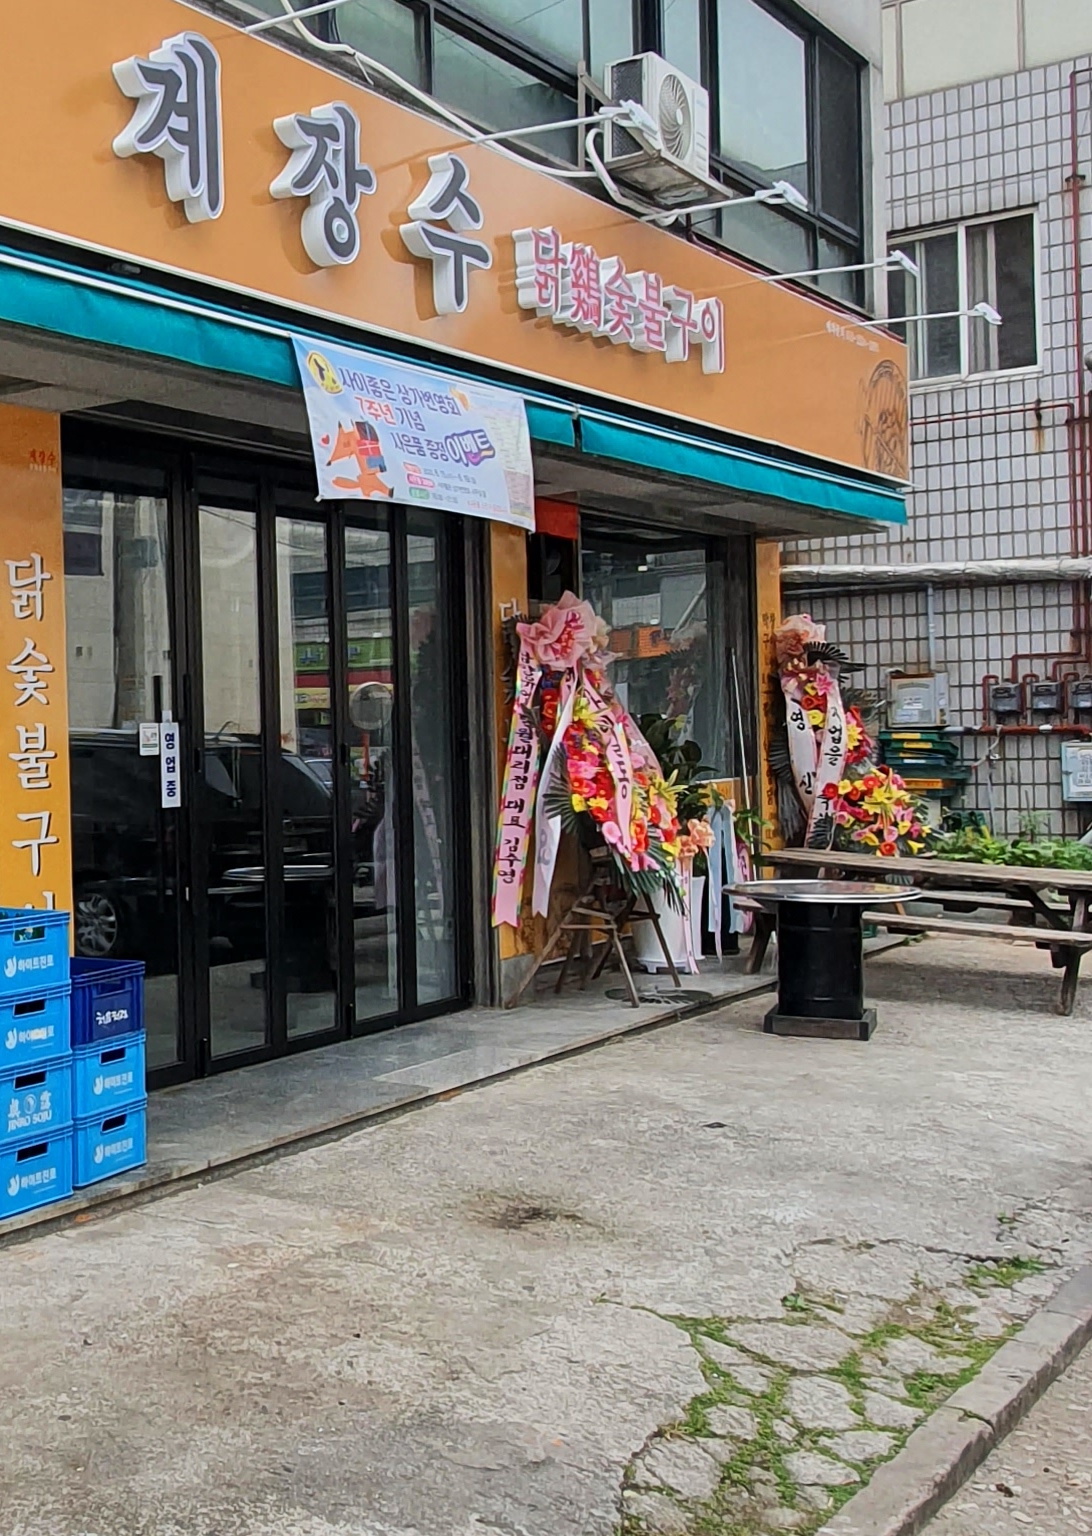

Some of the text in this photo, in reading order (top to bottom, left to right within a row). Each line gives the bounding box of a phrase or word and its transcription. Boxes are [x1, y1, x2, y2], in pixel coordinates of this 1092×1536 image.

[113, 31, 493, 316] 계장수
[395, 407, 425, 431] 기념
[444, 429, 495, 468] 이벤트
[164, 732, 176, 798] 영업중
